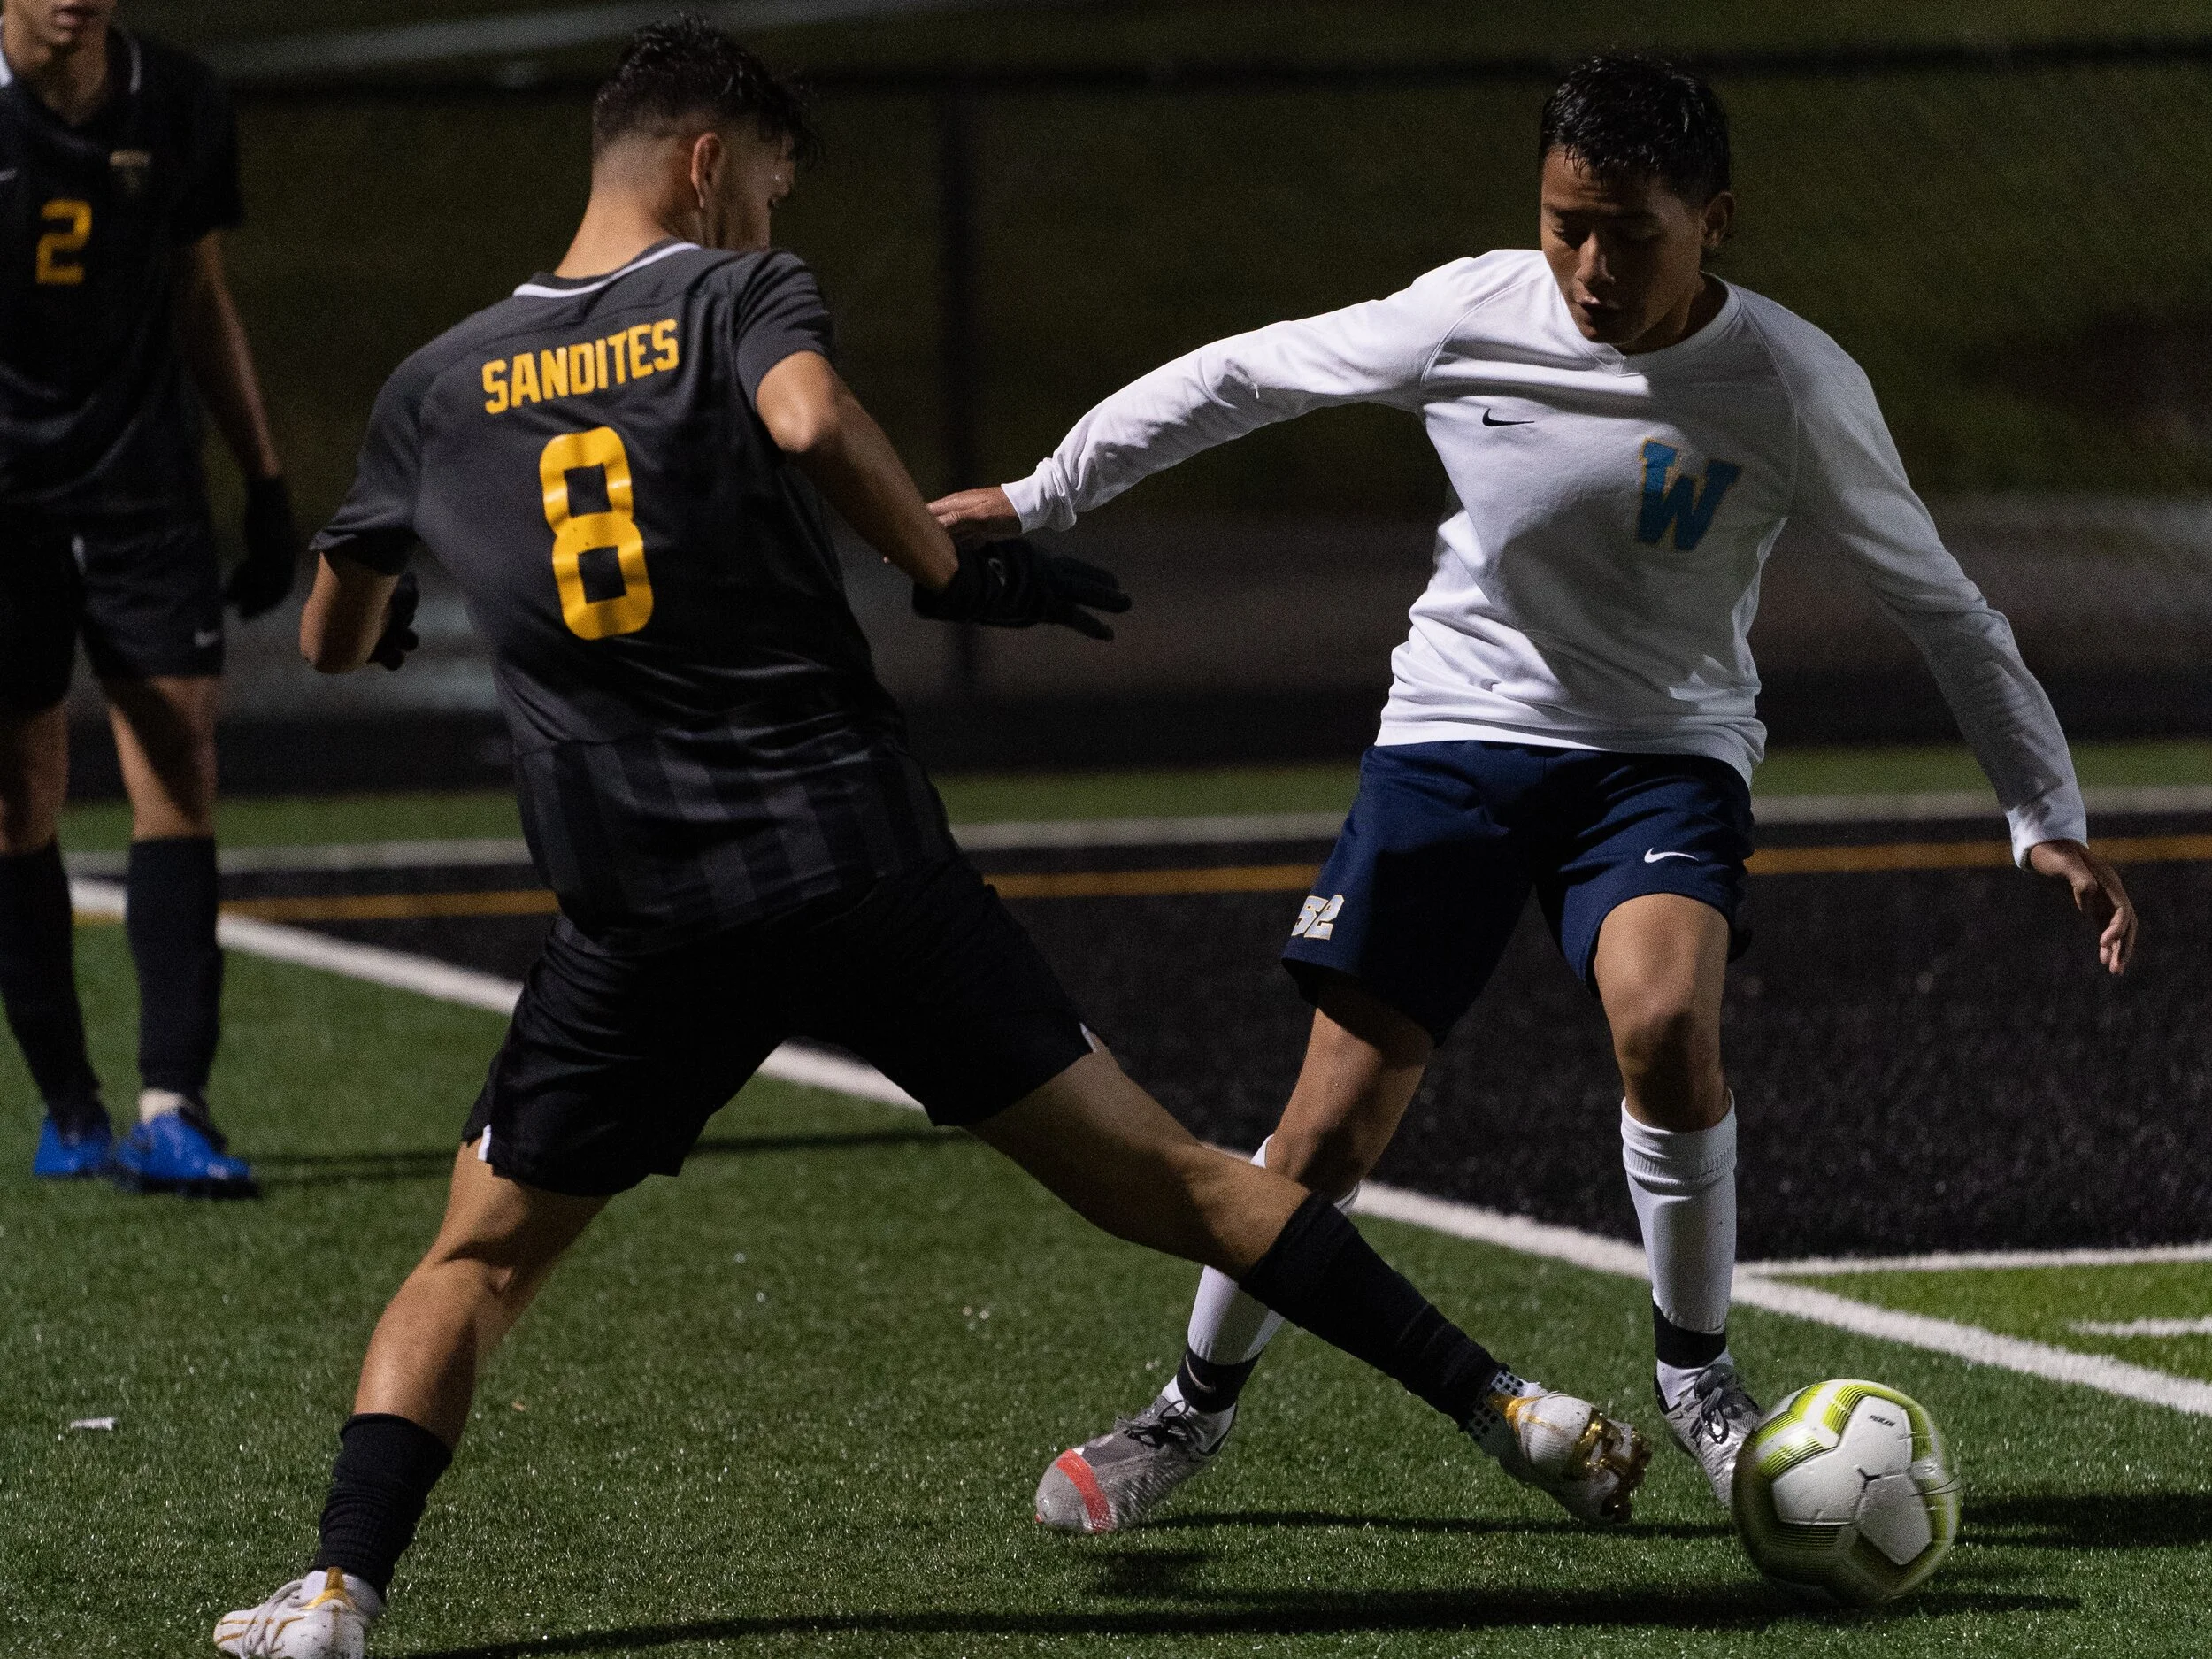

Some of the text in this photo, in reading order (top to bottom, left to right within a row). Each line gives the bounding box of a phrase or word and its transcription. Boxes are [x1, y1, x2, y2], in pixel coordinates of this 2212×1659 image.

[36, 198, 93, 285] 2
[481, 319, 680, 414] SANDITES
[539, 426, 654, 640] 8
[1638, 437, 1740, 551] W
